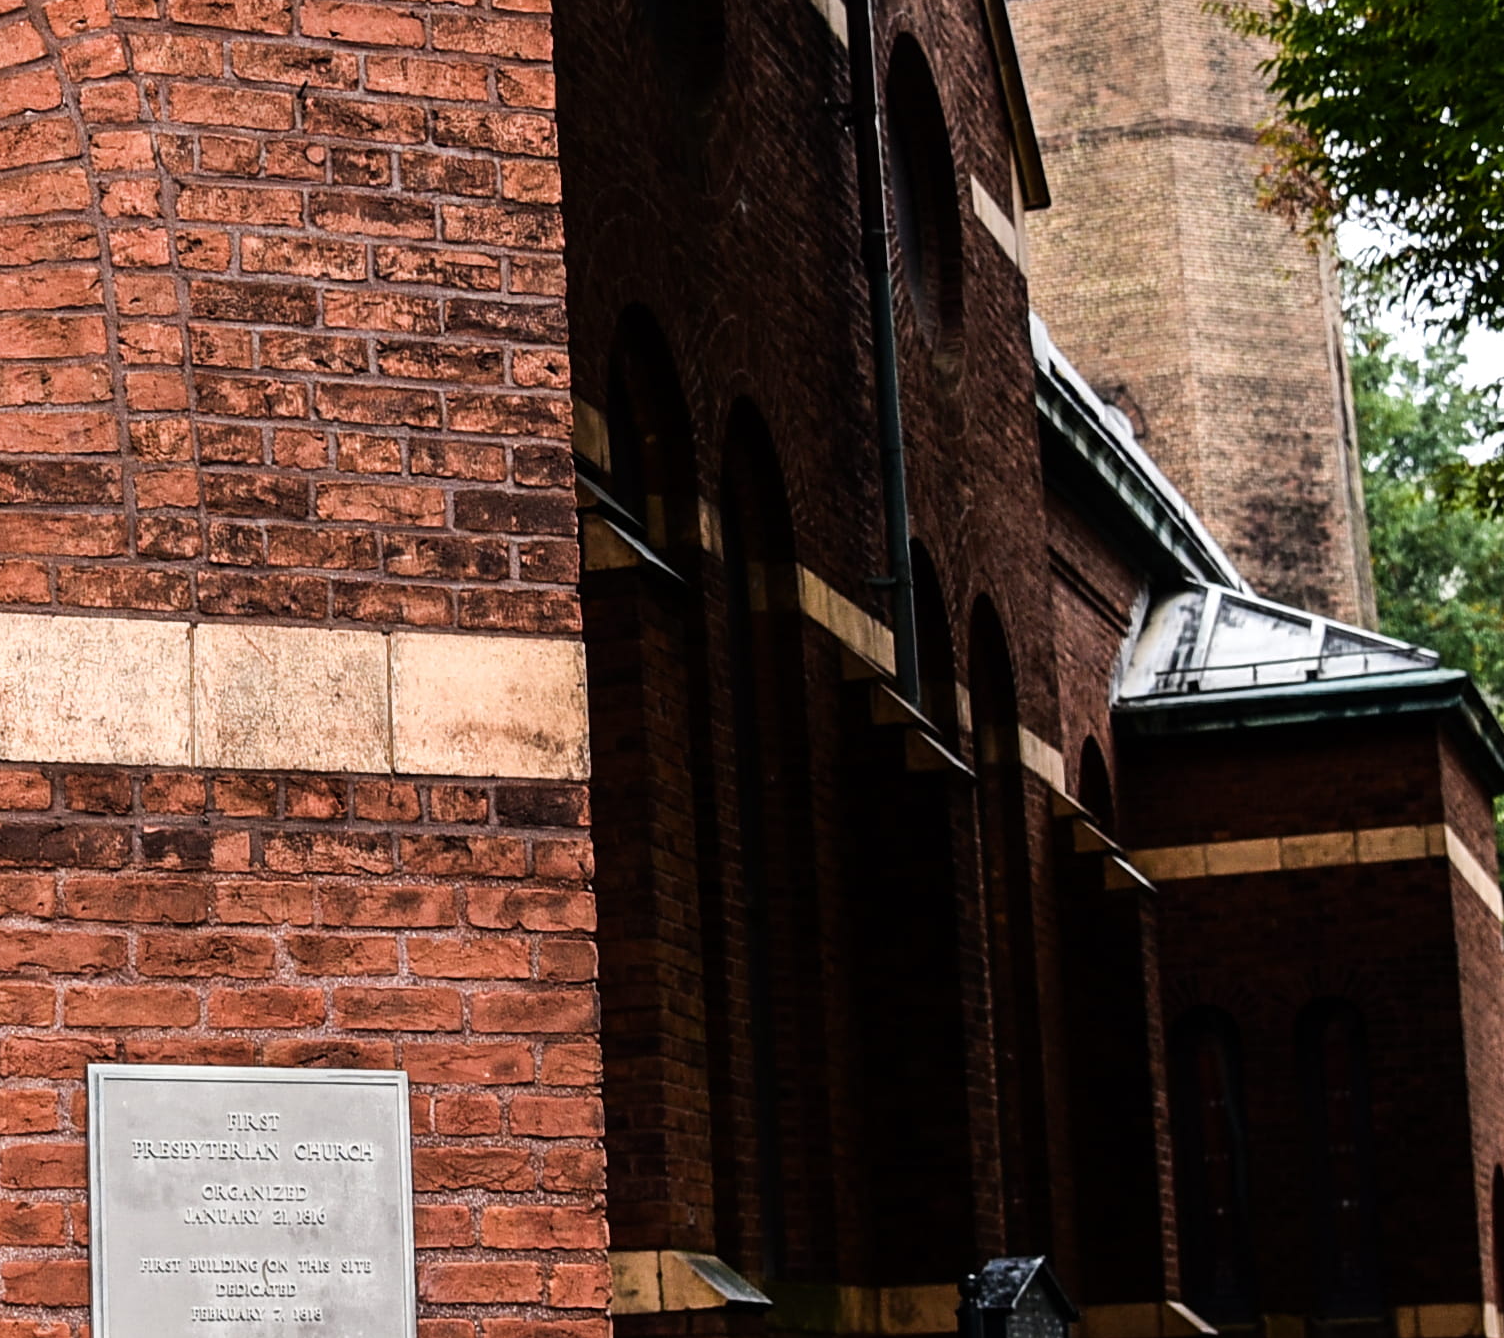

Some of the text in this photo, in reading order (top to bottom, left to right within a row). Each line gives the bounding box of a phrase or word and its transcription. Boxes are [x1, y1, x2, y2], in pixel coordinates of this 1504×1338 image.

[227, 1113, 280, 1131] FIRST
[132, 1140, 374, 1162] PRESBYTERIAN CHURCH
[202, 1184, 309, 1202] ORGANIZED
[183, 1209, 262, 1225] JANUARY
[296, 1206, 327, 1225] 1816
[140, 1258, 372, 1273] FIRST BUILDING ON THIS SITE
[215, 1283, 297, 1297] DEDICATED
[191, 1308, 265, 1322] FEBRUARY
